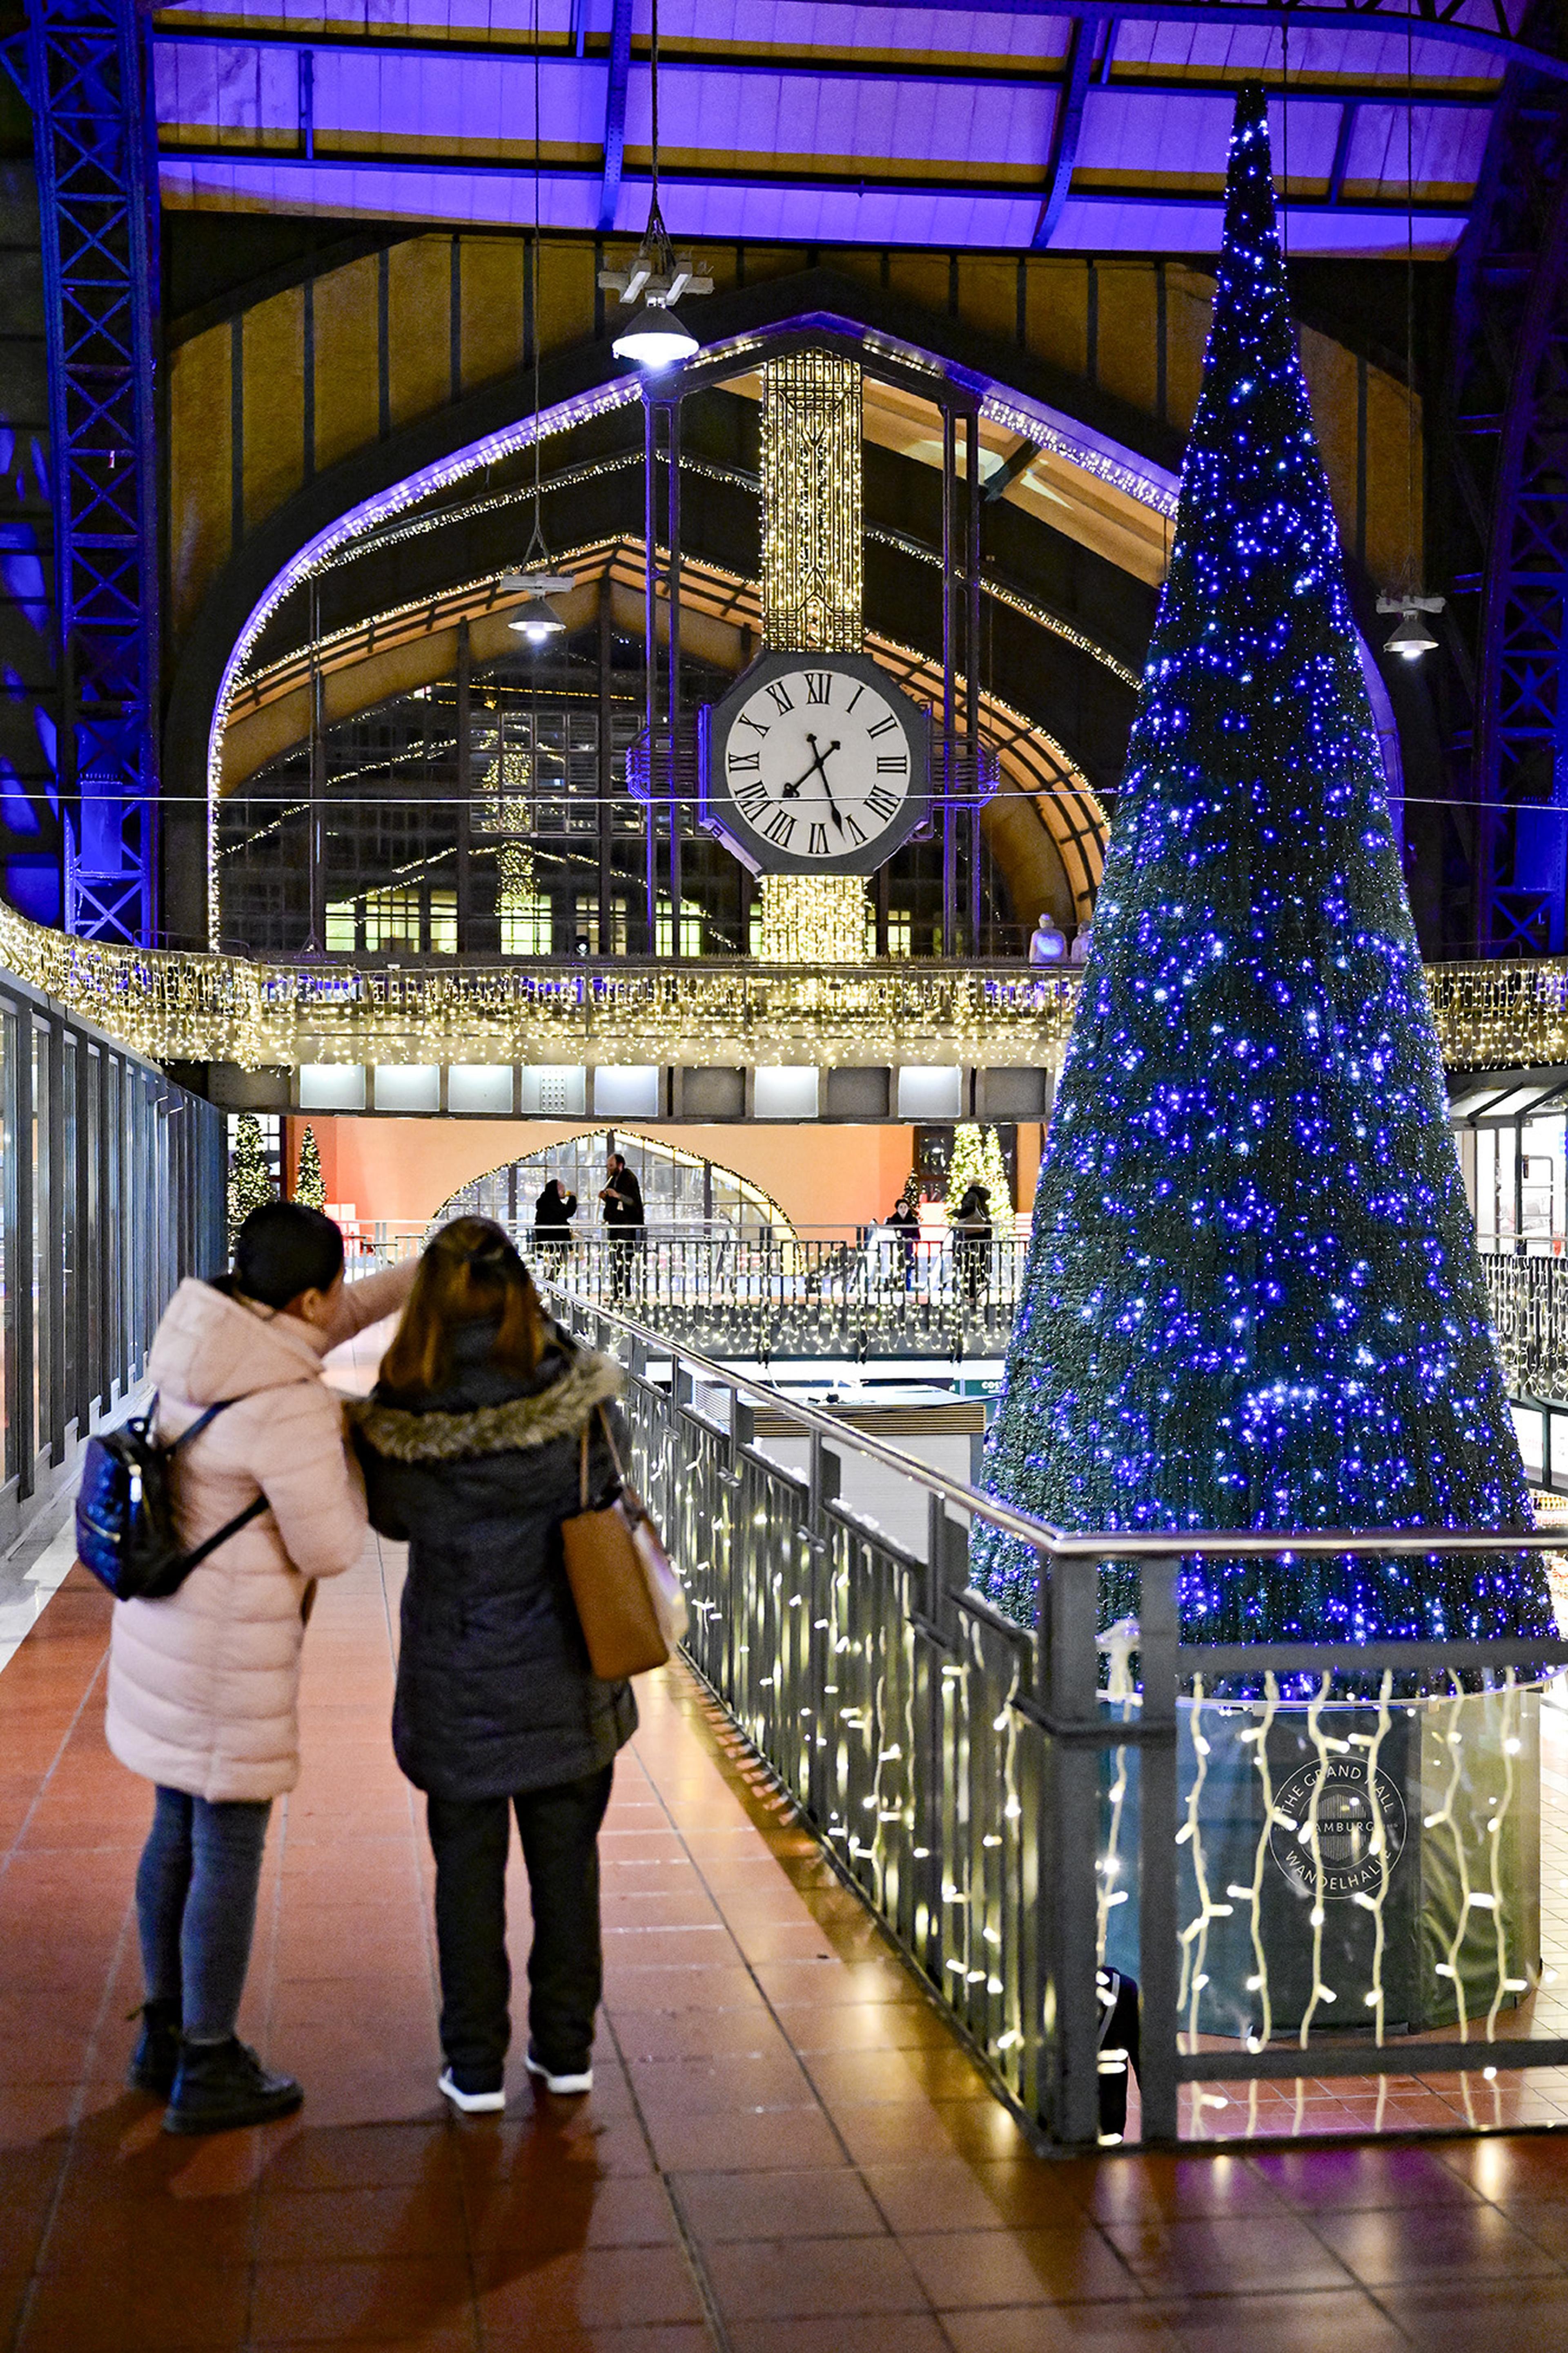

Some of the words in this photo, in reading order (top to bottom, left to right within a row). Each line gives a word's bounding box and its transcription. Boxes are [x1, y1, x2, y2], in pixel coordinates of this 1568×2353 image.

[765, 681, 795, 716] XI
[804, 673, 832, 705] XII
[846, 685, 866, 714] I
[738, 714, 770, 738] X
[867, 714, 898, 739] II
[728, 752, 760, 773] IX
[877, 755, 907, 775] III
[734, 780, 774, 824] VIII
[762, 808, 797, 849] VII
[808, 823, 831, 854] VI
[845, 814, 869, 846] V
[1280, 1785, 1304, 1814] THE
[1314, 1821, 1374, 1832] AMBURG
